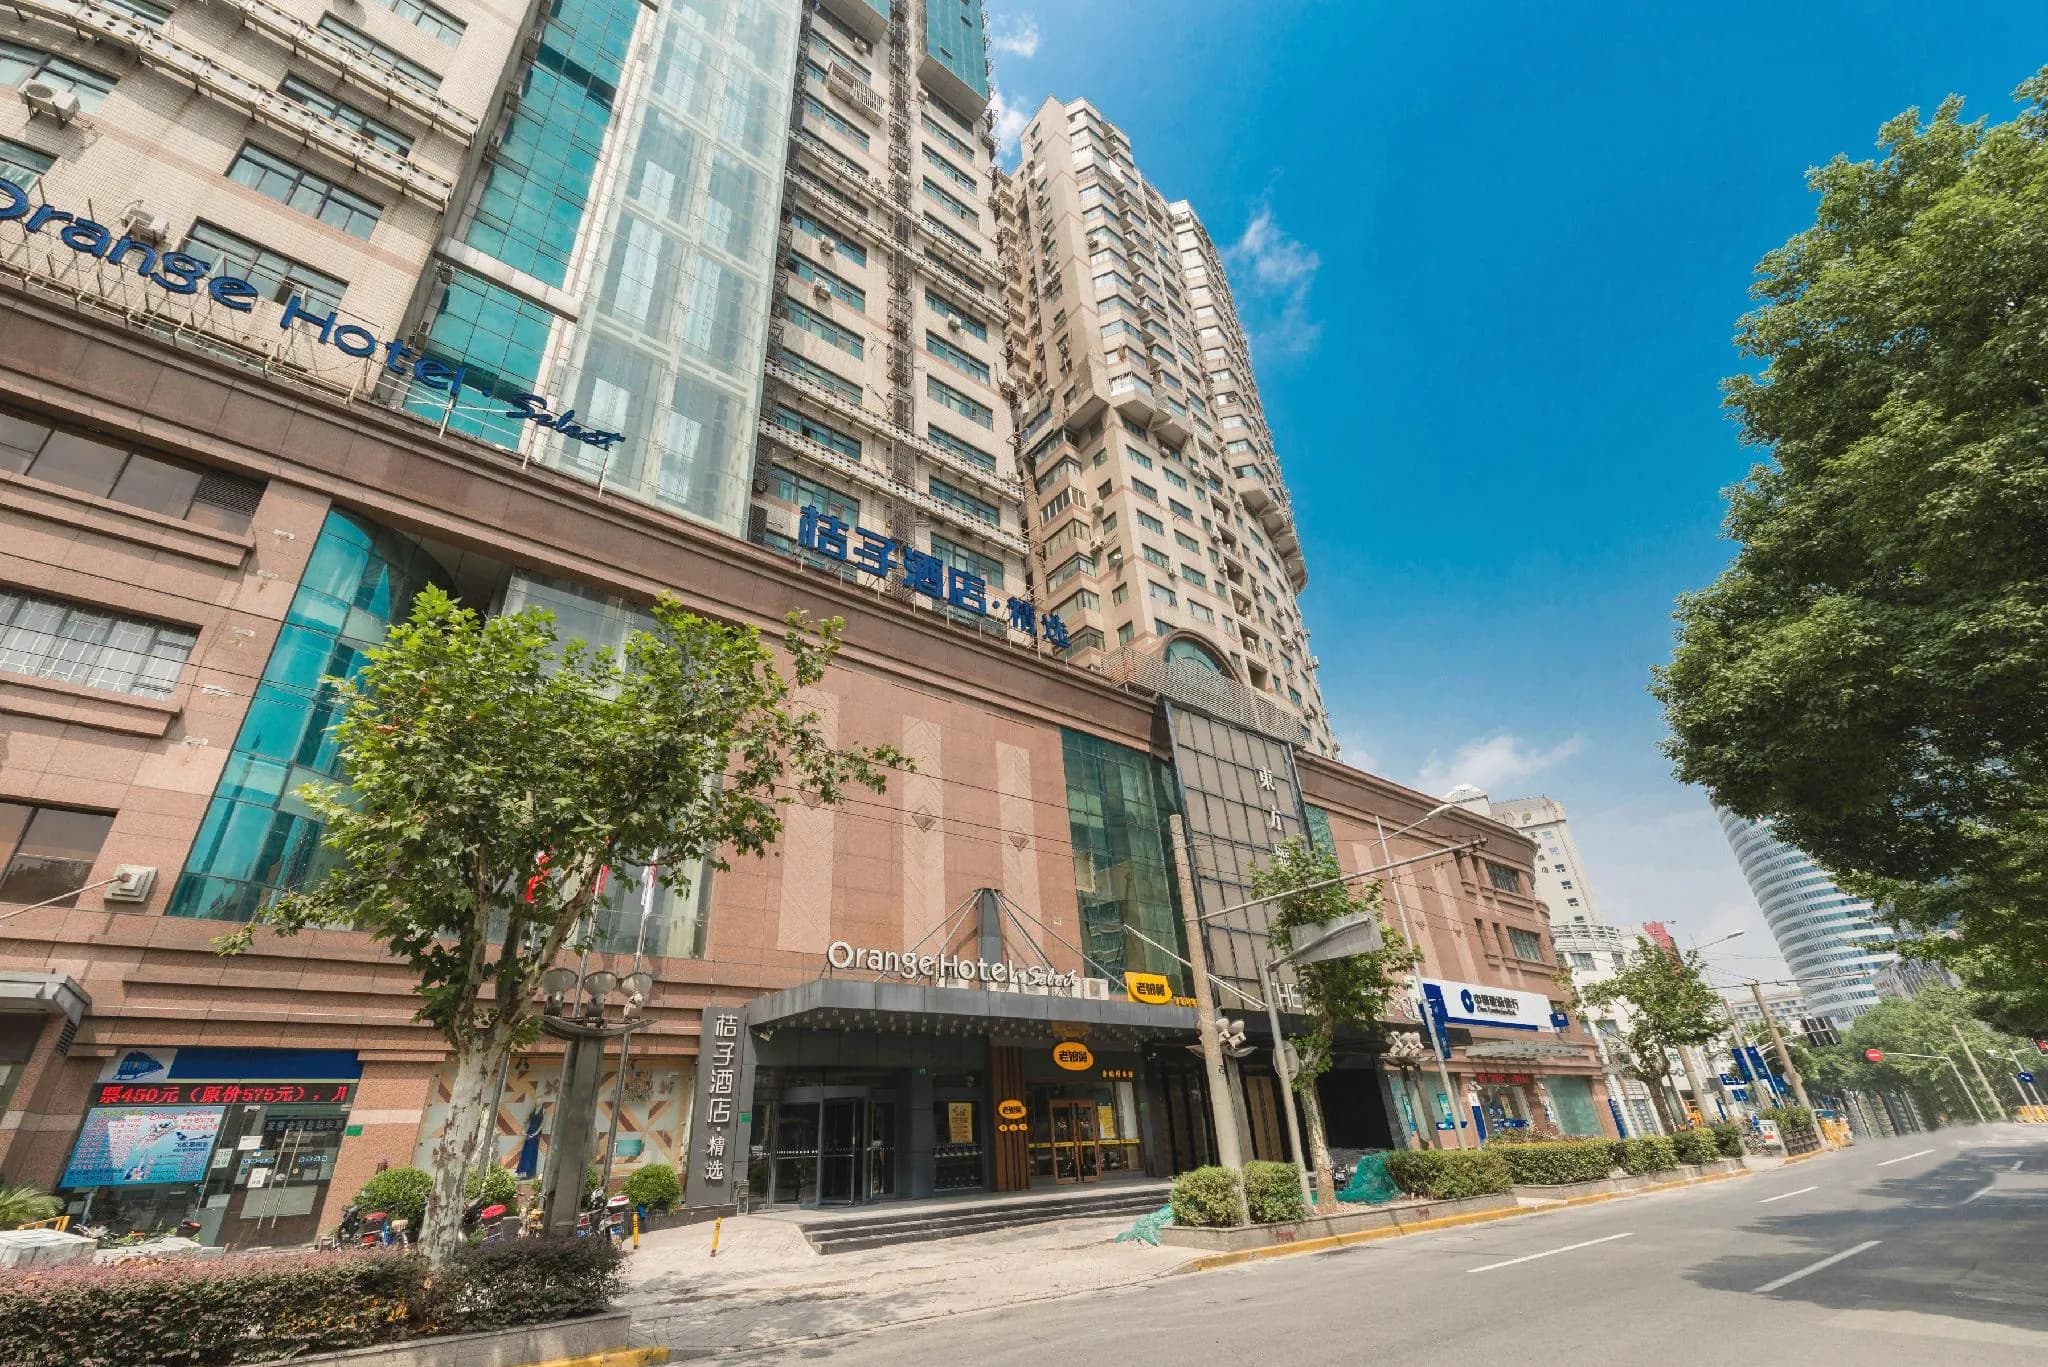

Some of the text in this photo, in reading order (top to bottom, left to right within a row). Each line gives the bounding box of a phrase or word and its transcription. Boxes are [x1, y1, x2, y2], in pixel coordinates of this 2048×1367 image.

[280, 295, 466, 397] Hotel
[506, 393, 626, 451] Select
[827, 940, 1077, 987] Orange Hotel Select
